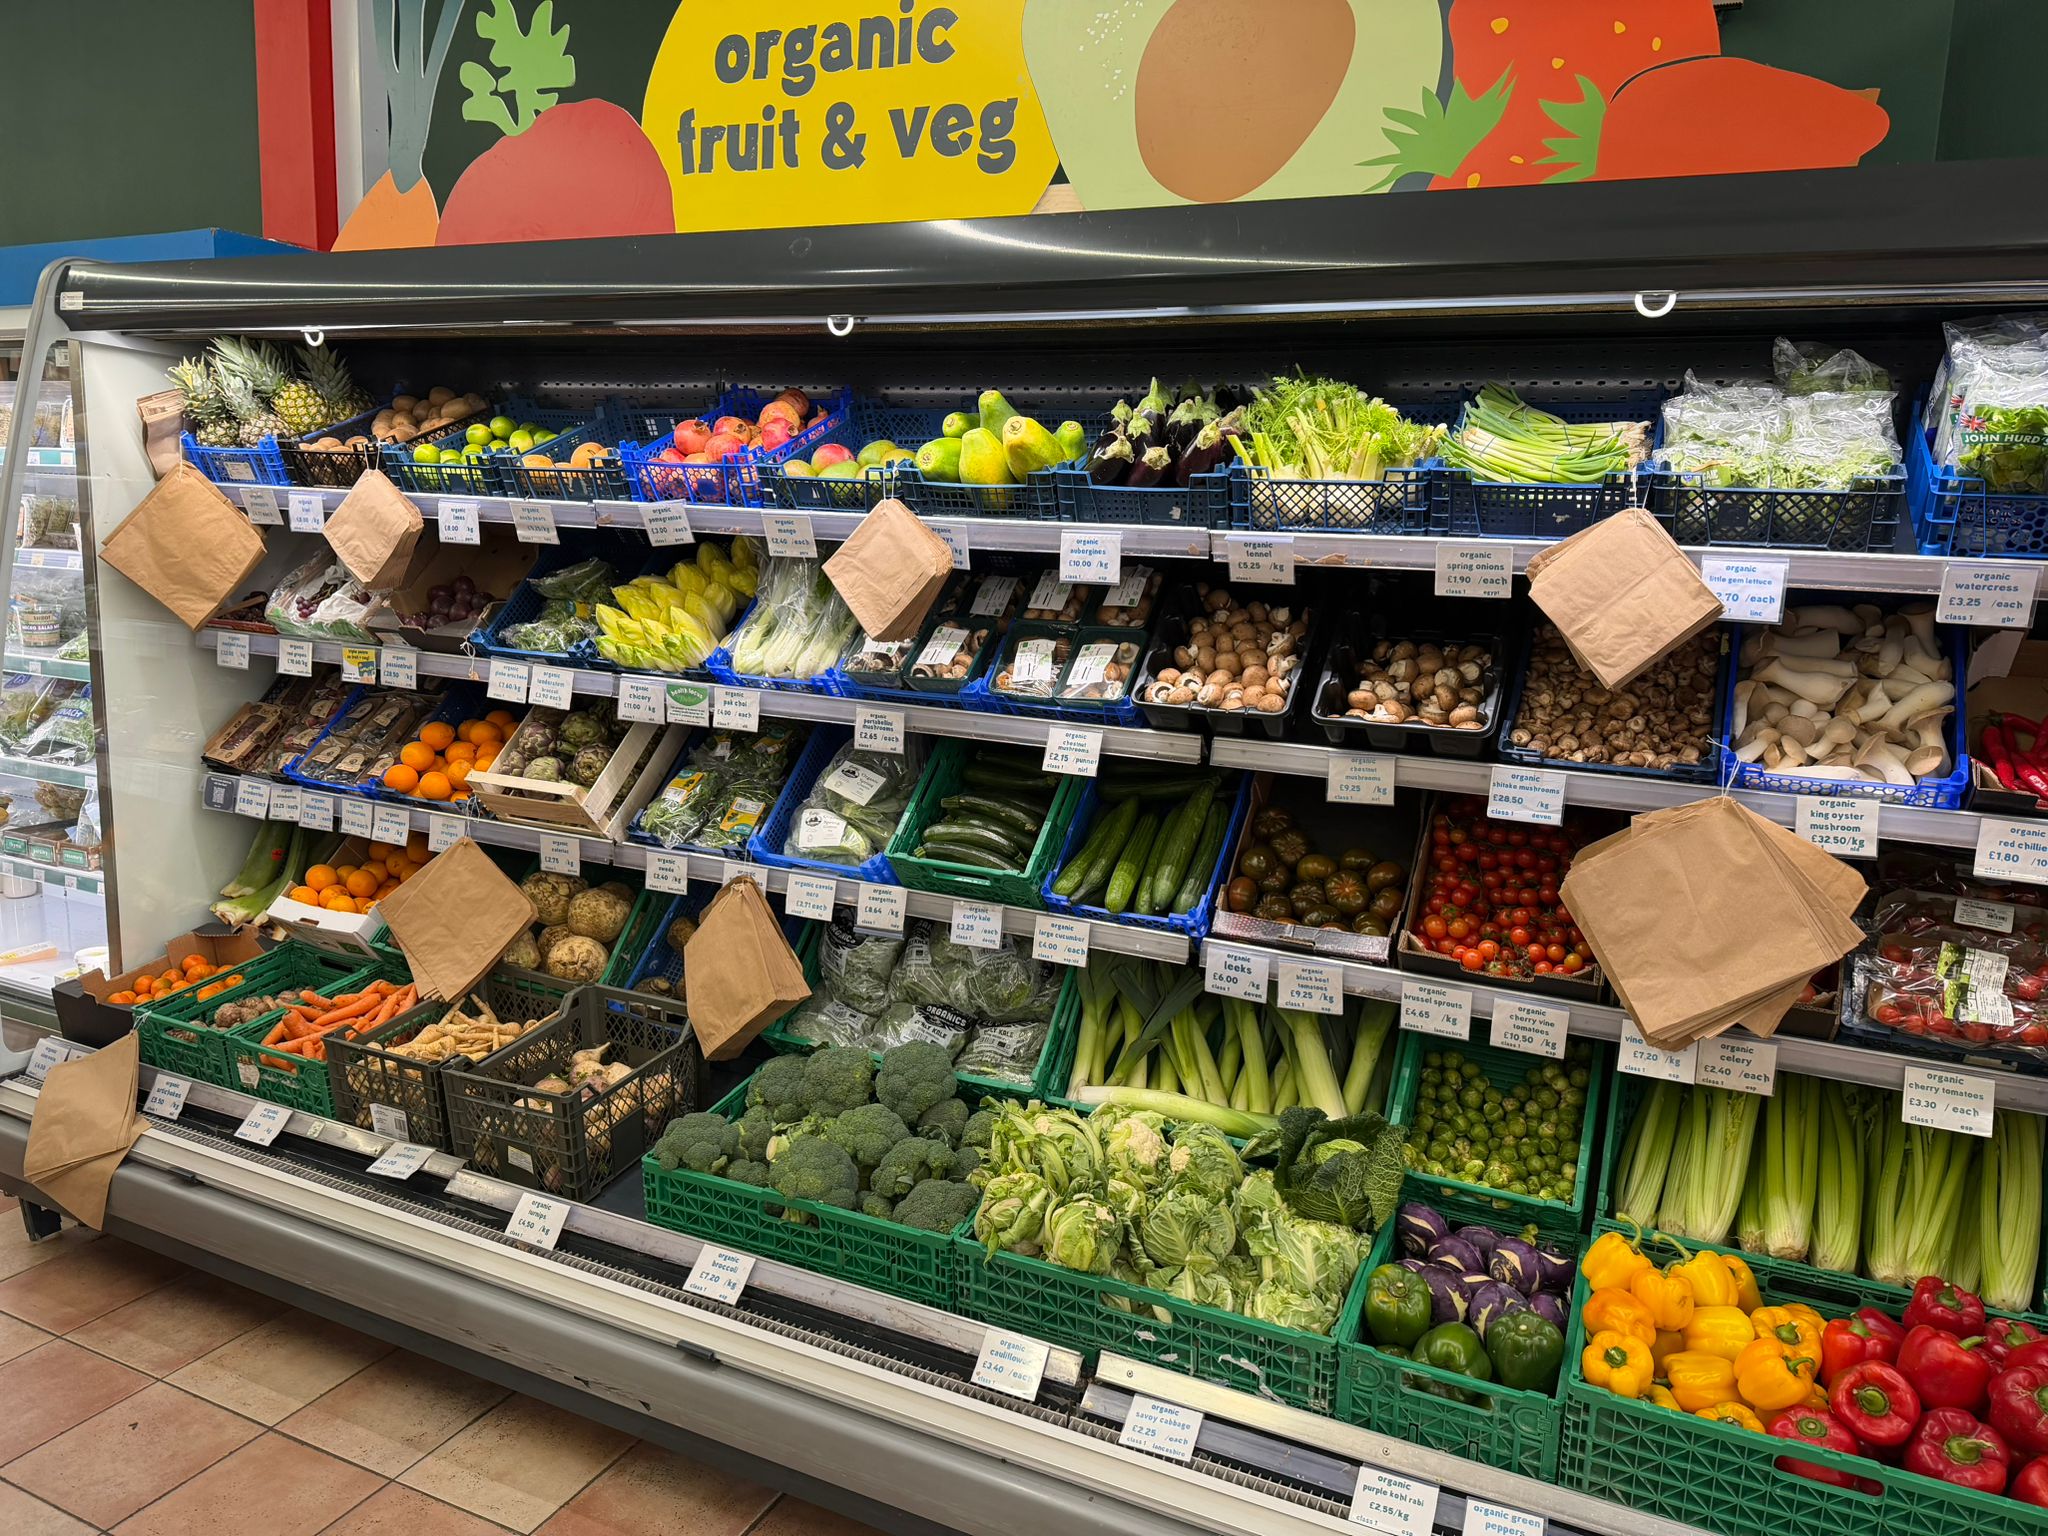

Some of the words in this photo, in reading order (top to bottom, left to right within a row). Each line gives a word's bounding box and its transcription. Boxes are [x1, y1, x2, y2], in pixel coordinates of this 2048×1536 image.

[714, 0, 959, 97] organic
[677, 104, 800, 175] fruit
[820, 101, 867, 170] &
[888, 97, 1019, 175] veg
[1964, 434, 2000, 444] JOHN
[1076, 538, 1098, 546] organic
[1244, 541, 1272, 550] organic
[1460, 551, 1491, 561] organic
[1096, 561, 1108, 569] /kg
[1238, 561, 1260, 570] £5.25
[1269, 562, 1284, 571] /kg
[1447, 562, 1473, 572] spring
[1476, 562, 1504, 571] onions
[1726, 565, 1756, 574] organic
[1448, 576, 1470, 584] £1.90
[1478, 576, 1507, 585] /each
[1709, 575, 1726, 584] little
[1728, 577, 1743, 586] gem
[1745, 577, 1772, 585] lettuce
[1974, 572, 2010, 582] organic
[1955, 583, 2019, 593] watercress
[1745, 593, 1775, 604] /each
[1949, 596, 1981, 608] £3.25
[1991, 599, 2023, 610] /each
[859, 732, 877, 740] £2.65
[1058, 745, 1089, 754] mushrooms
[1049, 753, 1069, 762] £2.15
[1511, 773, 1540, 783] organic
[1339, 783, 1361, 792] £9.25
[1518, 784, 1560, 795] mushrooms
[1492, 794, 1523, 805] £28.50
[1536, 798, 1549, 809] /kg
[1819, 798, 1856, 809] organic
[1810, 810, 1830, 822] king
[1832, 811, 1864, 823] oyster
[1810, 822, 1861, 832] mushroom
[2010, 826, 2046, 839] organic
[1811, 834, 1865, 848] £32.50/kg
[1999, 838, 2015, 849] red
[1989, 851, 2019, 864] £1.80
[1051, 922, 1074, 932] organic
[1039, 929, 1054, 939] large
[1038, 941, 1057, 951] £4.00
[1227, 952, 1251, 963] organic
[1224, 961, 1253, 975] leeks
[1301, 967, 1323, 976] organic
[1213, 973, 1238, 985] £6.00
[1295, 974, 1313, 982] black
[1290, 989, 1313, 1000] £9.25
[1319, 992, 1334, 1004] /kg
[1418, 986, 1447, 997] organic
[1404, 993, 1432, 1005] brussel
[1433, 998, 1462, 1010] sprouts
[926, 1005, 967, 1027] ORGANICS
[1405, 1008, 1430, 1019] £4.65
[1441, 1013, 1457, 1026] /kg
[1518, 1006, 1546, 1017] organic
[1509, 1013, 1536, 1025] cherry
[1538, 1017, 1555, 1027] vine
[1513, 1023, 1549, 1036] tomatoes
[1503, 1031, 1533, 1044] £10.50
[1540, 1037, 1557, 1050] /kg
[1720, 1043, 1754, 1055] organic
[1633, 1051, 1658, 1062] £7.20
[1664, 1054, 1681, 1067] /kg
[1720, 1053, 1752, 1066] celery
[1703, 1064, 1731, 1075] £2.40
[1738, 1069, 1770, 1083] /each
[1926, 1072, 1964, 1085] organic
[1909, 1082, 1940, 1096] cherry
[1942, 1087, 1984, 1100] tomatoes
[1909, 1097, 1937, 1109] £3.30
[531, 1200, 552, 1211] organic
[518, 1219, 534, 1229] £4.50
[718, 1252, 740, 1263] organic
[712, 1260, 738, 1273] broccoli
[699, 1272, 720, 1282] £7.20
[1000, 1339, 1025, 1352] organic
[982, 1360, 1004, 1374] £3.40
[1151, 1403, 1179, 1416] organic
[1135, 1411, 1158, 1423] savoy
[1159, 1416, 1191, 1430] cabbage
[1131, 1424, 1157, 1437] £2.25
[1164, 1435, 1188, 1446] /each
[1377, 1474, 1411, 1491] organic
[1362, 1483, 1388, 1497] purple
[1389, 1490, 1407, 1502] kohl
[1409, 1496, 1424, 1507] rabi
[1369, 1501, 1410, 1521] £2.55/kg
[1473, 1504, 1509, 1519] organic
[1512, 1512, 1540, 1528] green
